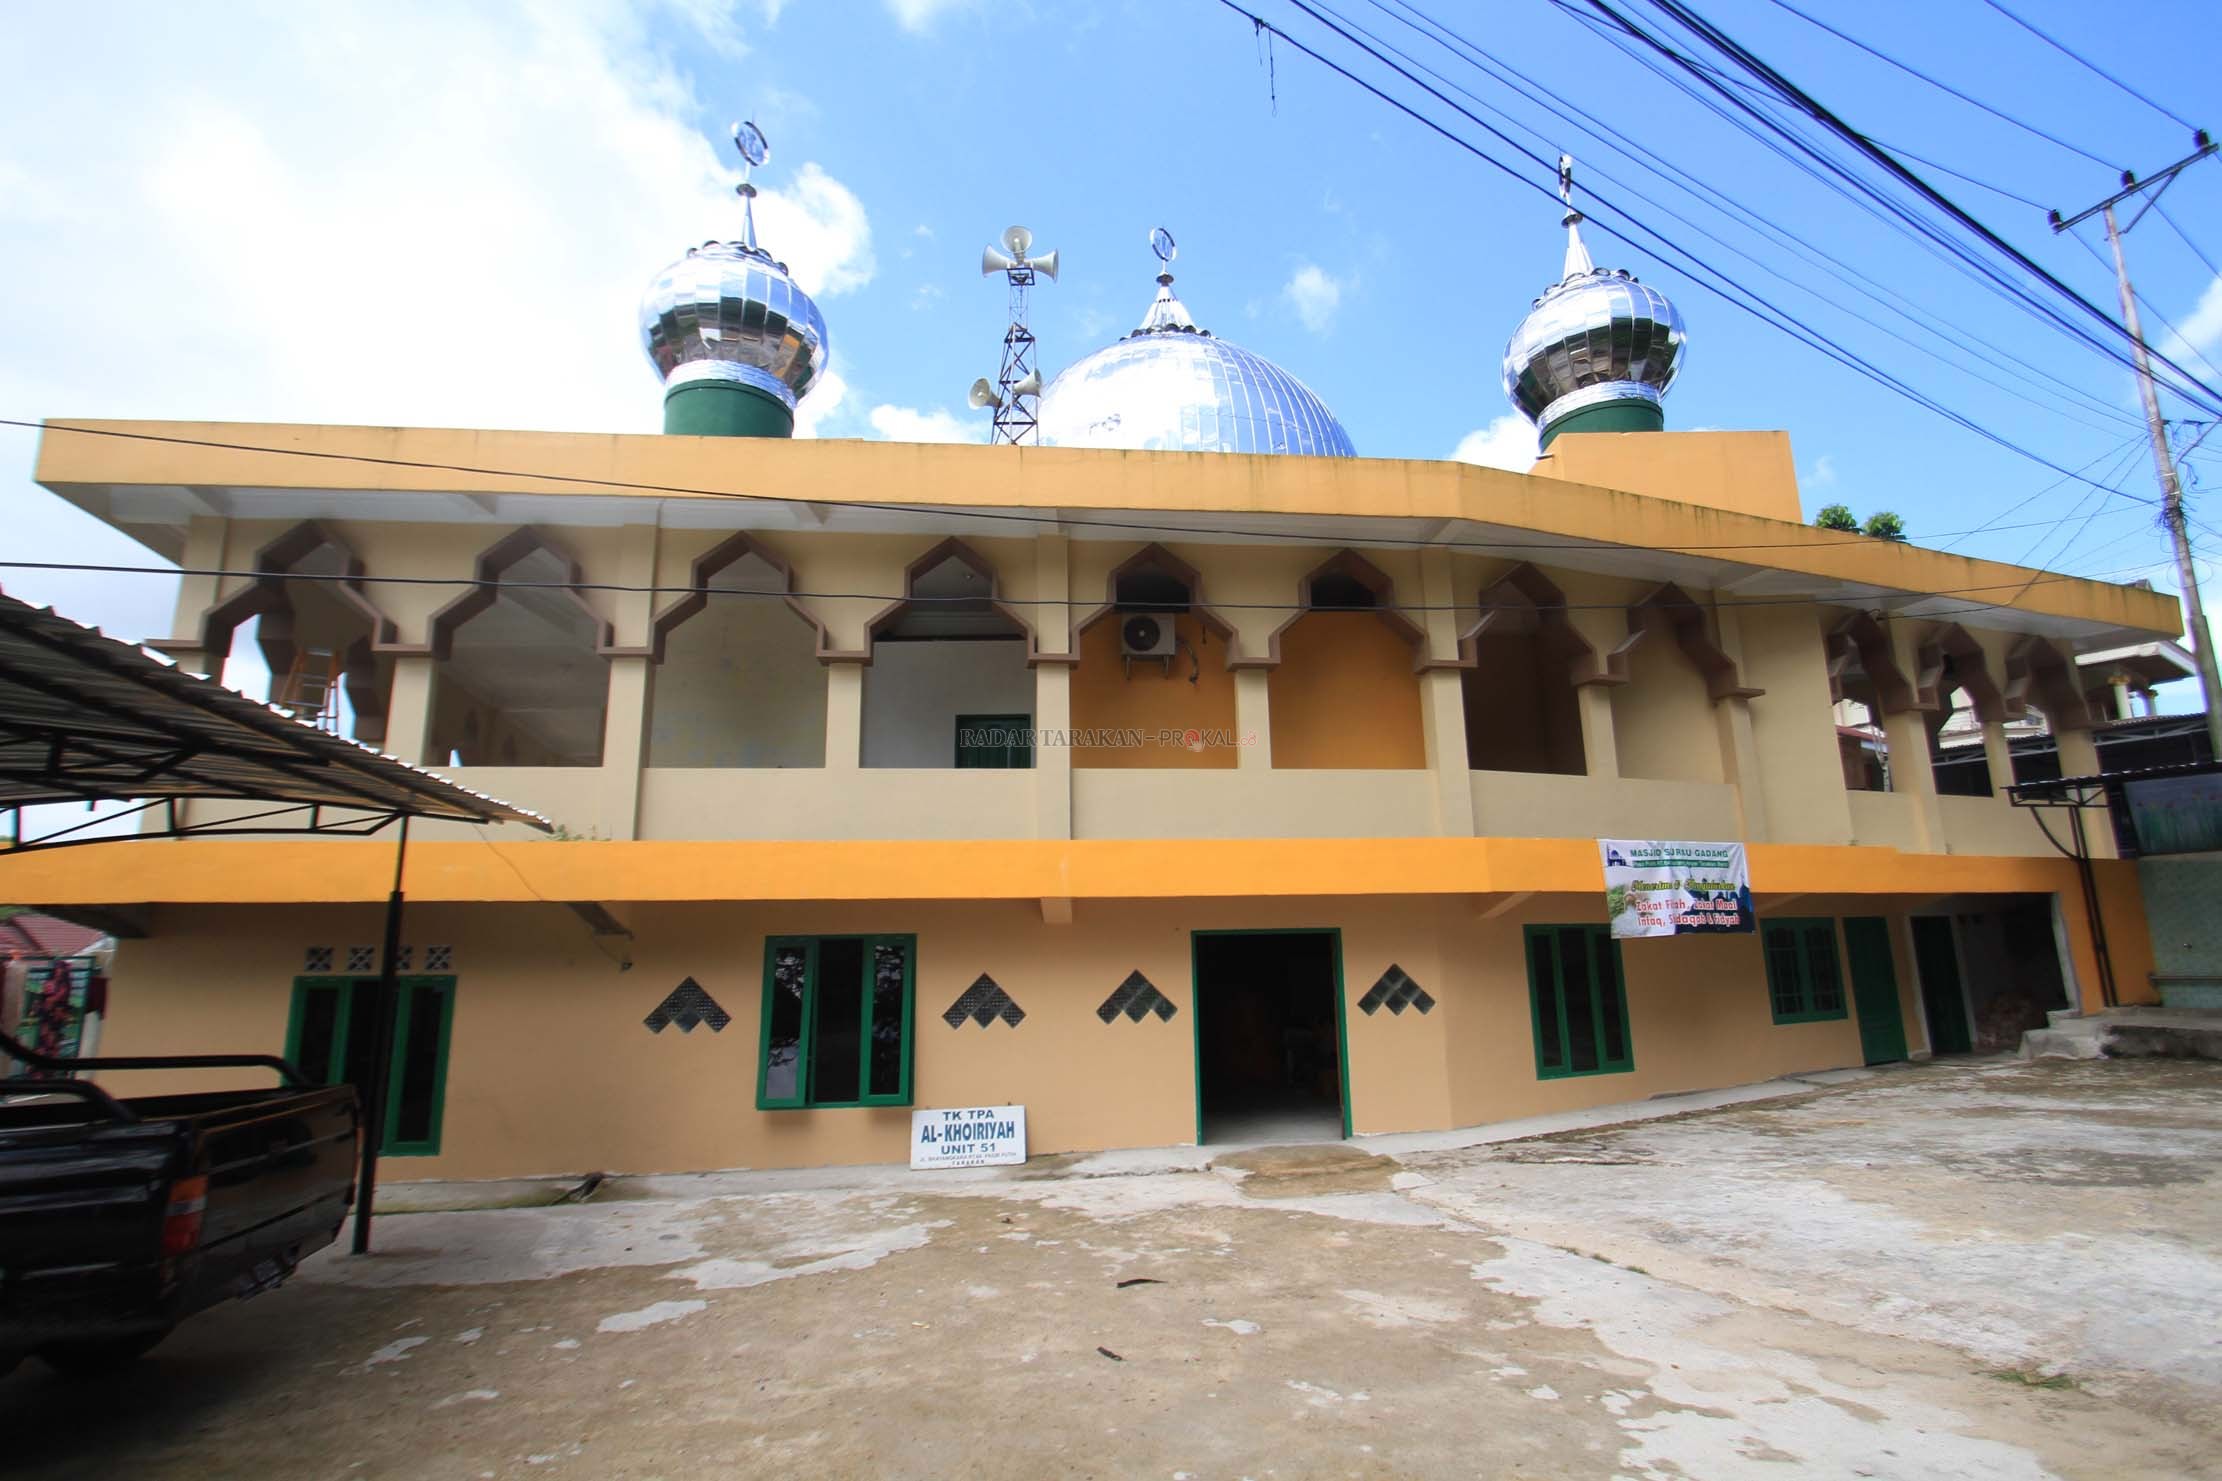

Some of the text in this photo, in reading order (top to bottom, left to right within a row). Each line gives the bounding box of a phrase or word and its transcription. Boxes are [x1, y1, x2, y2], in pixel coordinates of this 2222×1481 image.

[1630, 849, 1662, 857] MASJID
[1694, 849, 1729, 858] GADANG
[1636, 901, 1662, 911] Zakat
[1716, 900, 1737, 910] Maal
[943, 1110, 994, 1121] TK TPA
[941, 1143, 996, 1155] UNIT 51
